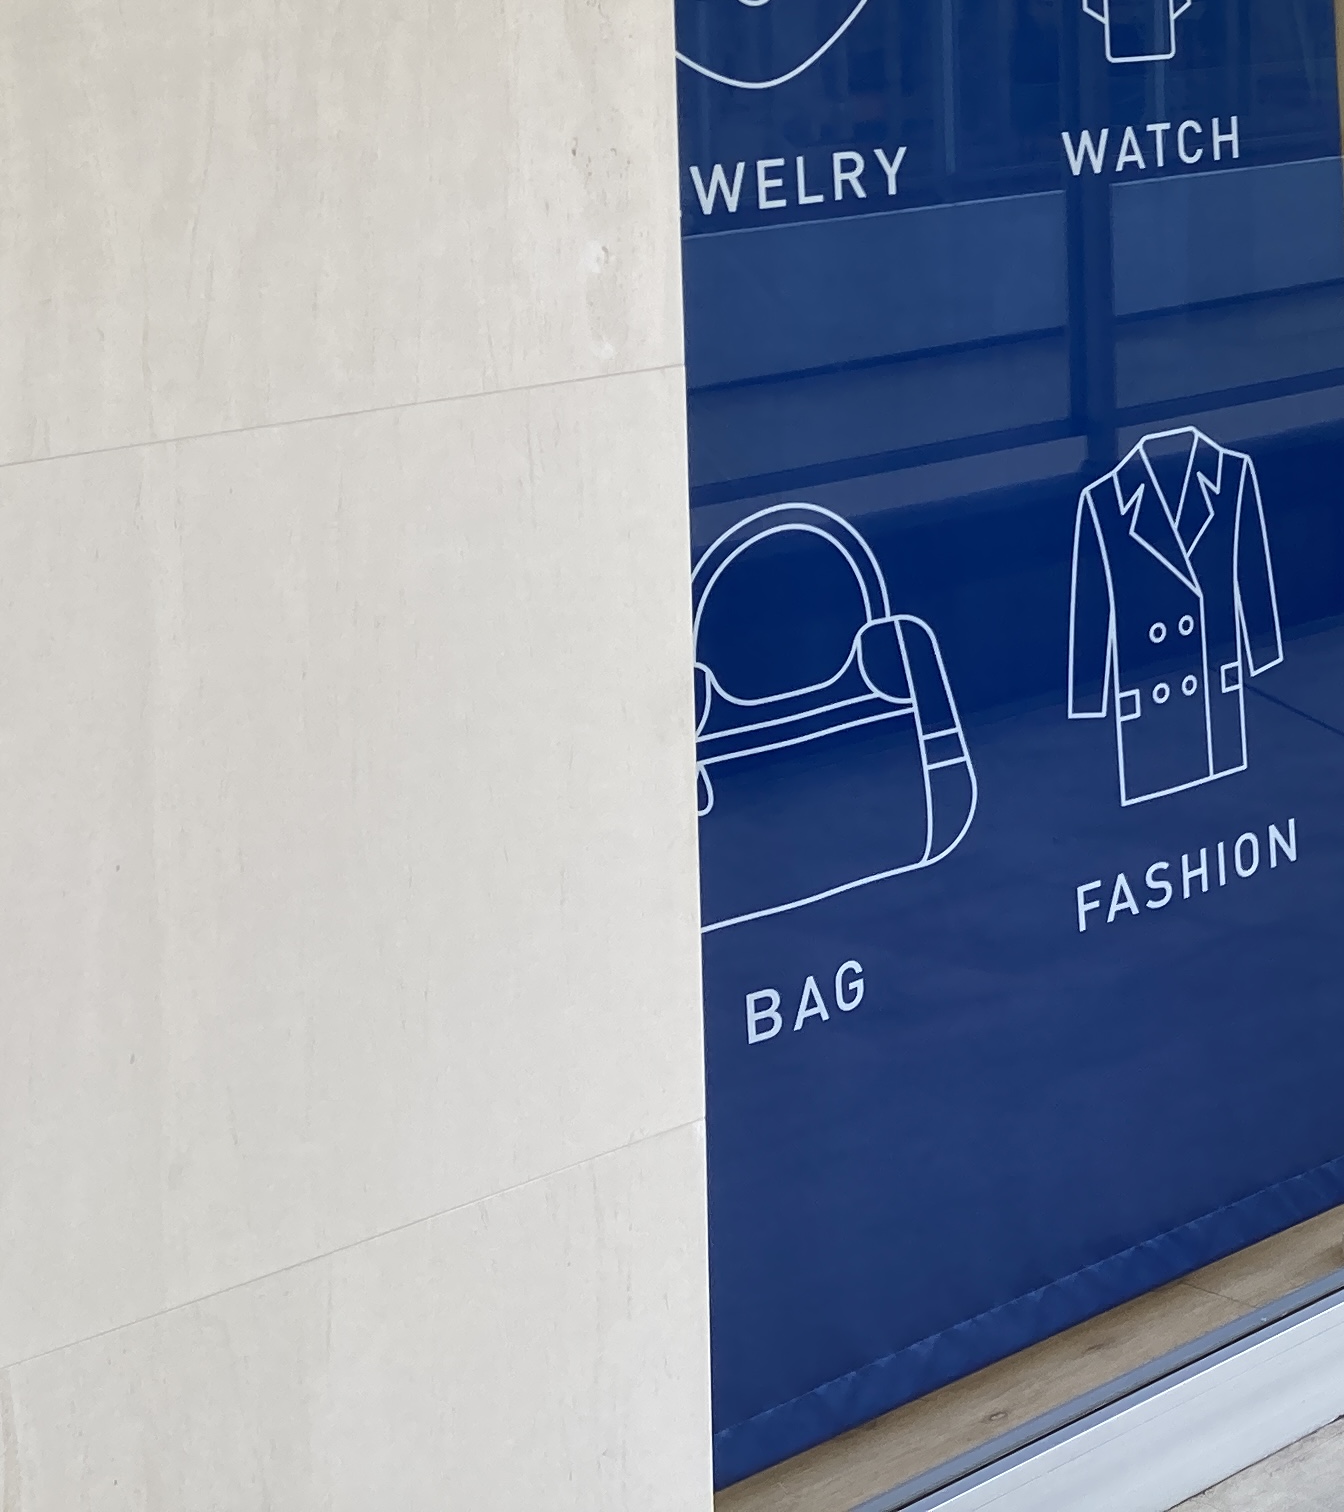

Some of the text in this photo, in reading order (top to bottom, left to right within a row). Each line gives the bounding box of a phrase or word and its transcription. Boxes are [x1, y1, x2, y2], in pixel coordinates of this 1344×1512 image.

[1060, 114, 1241, 177] WATCH
[1076, 817, 1299, 933] FASHION
[745, 959, 866, 1045] BAG
